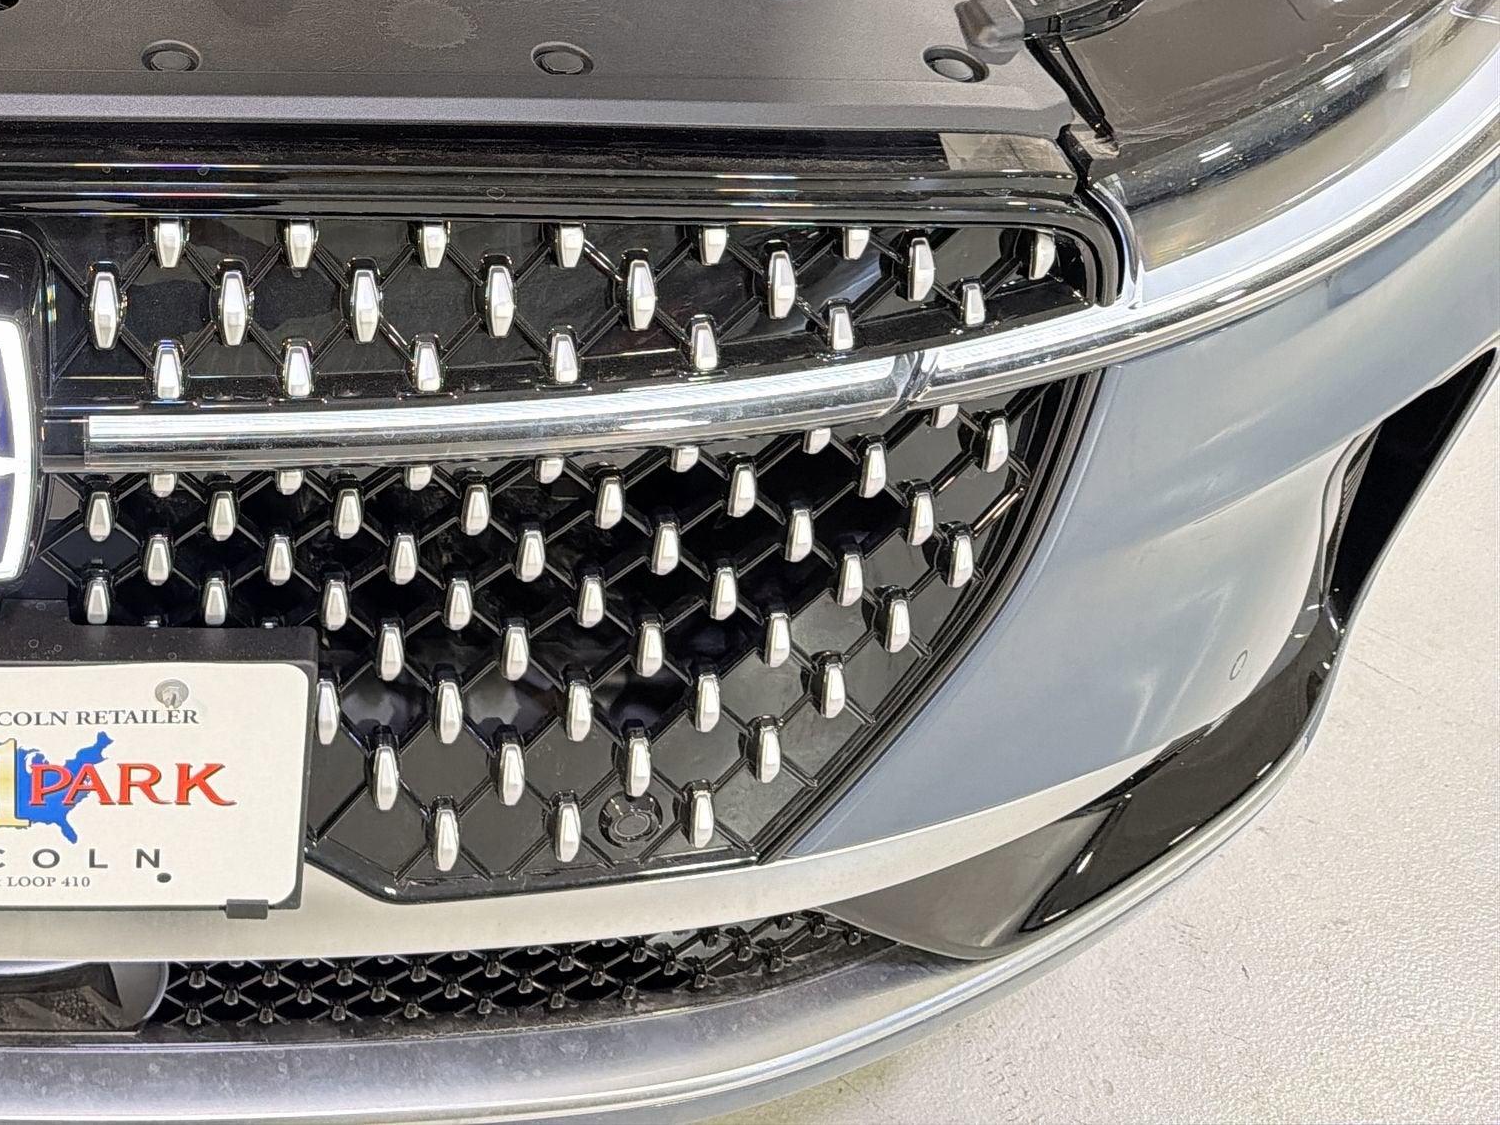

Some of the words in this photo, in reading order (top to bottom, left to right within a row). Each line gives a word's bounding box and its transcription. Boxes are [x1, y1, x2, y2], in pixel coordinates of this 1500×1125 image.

[76, 710, 199, 725] RETAILER
[28, 762, 237, 806] PARK
[6, 875, 56, 887] LOOP
[60, 875, 91, 888] 410
